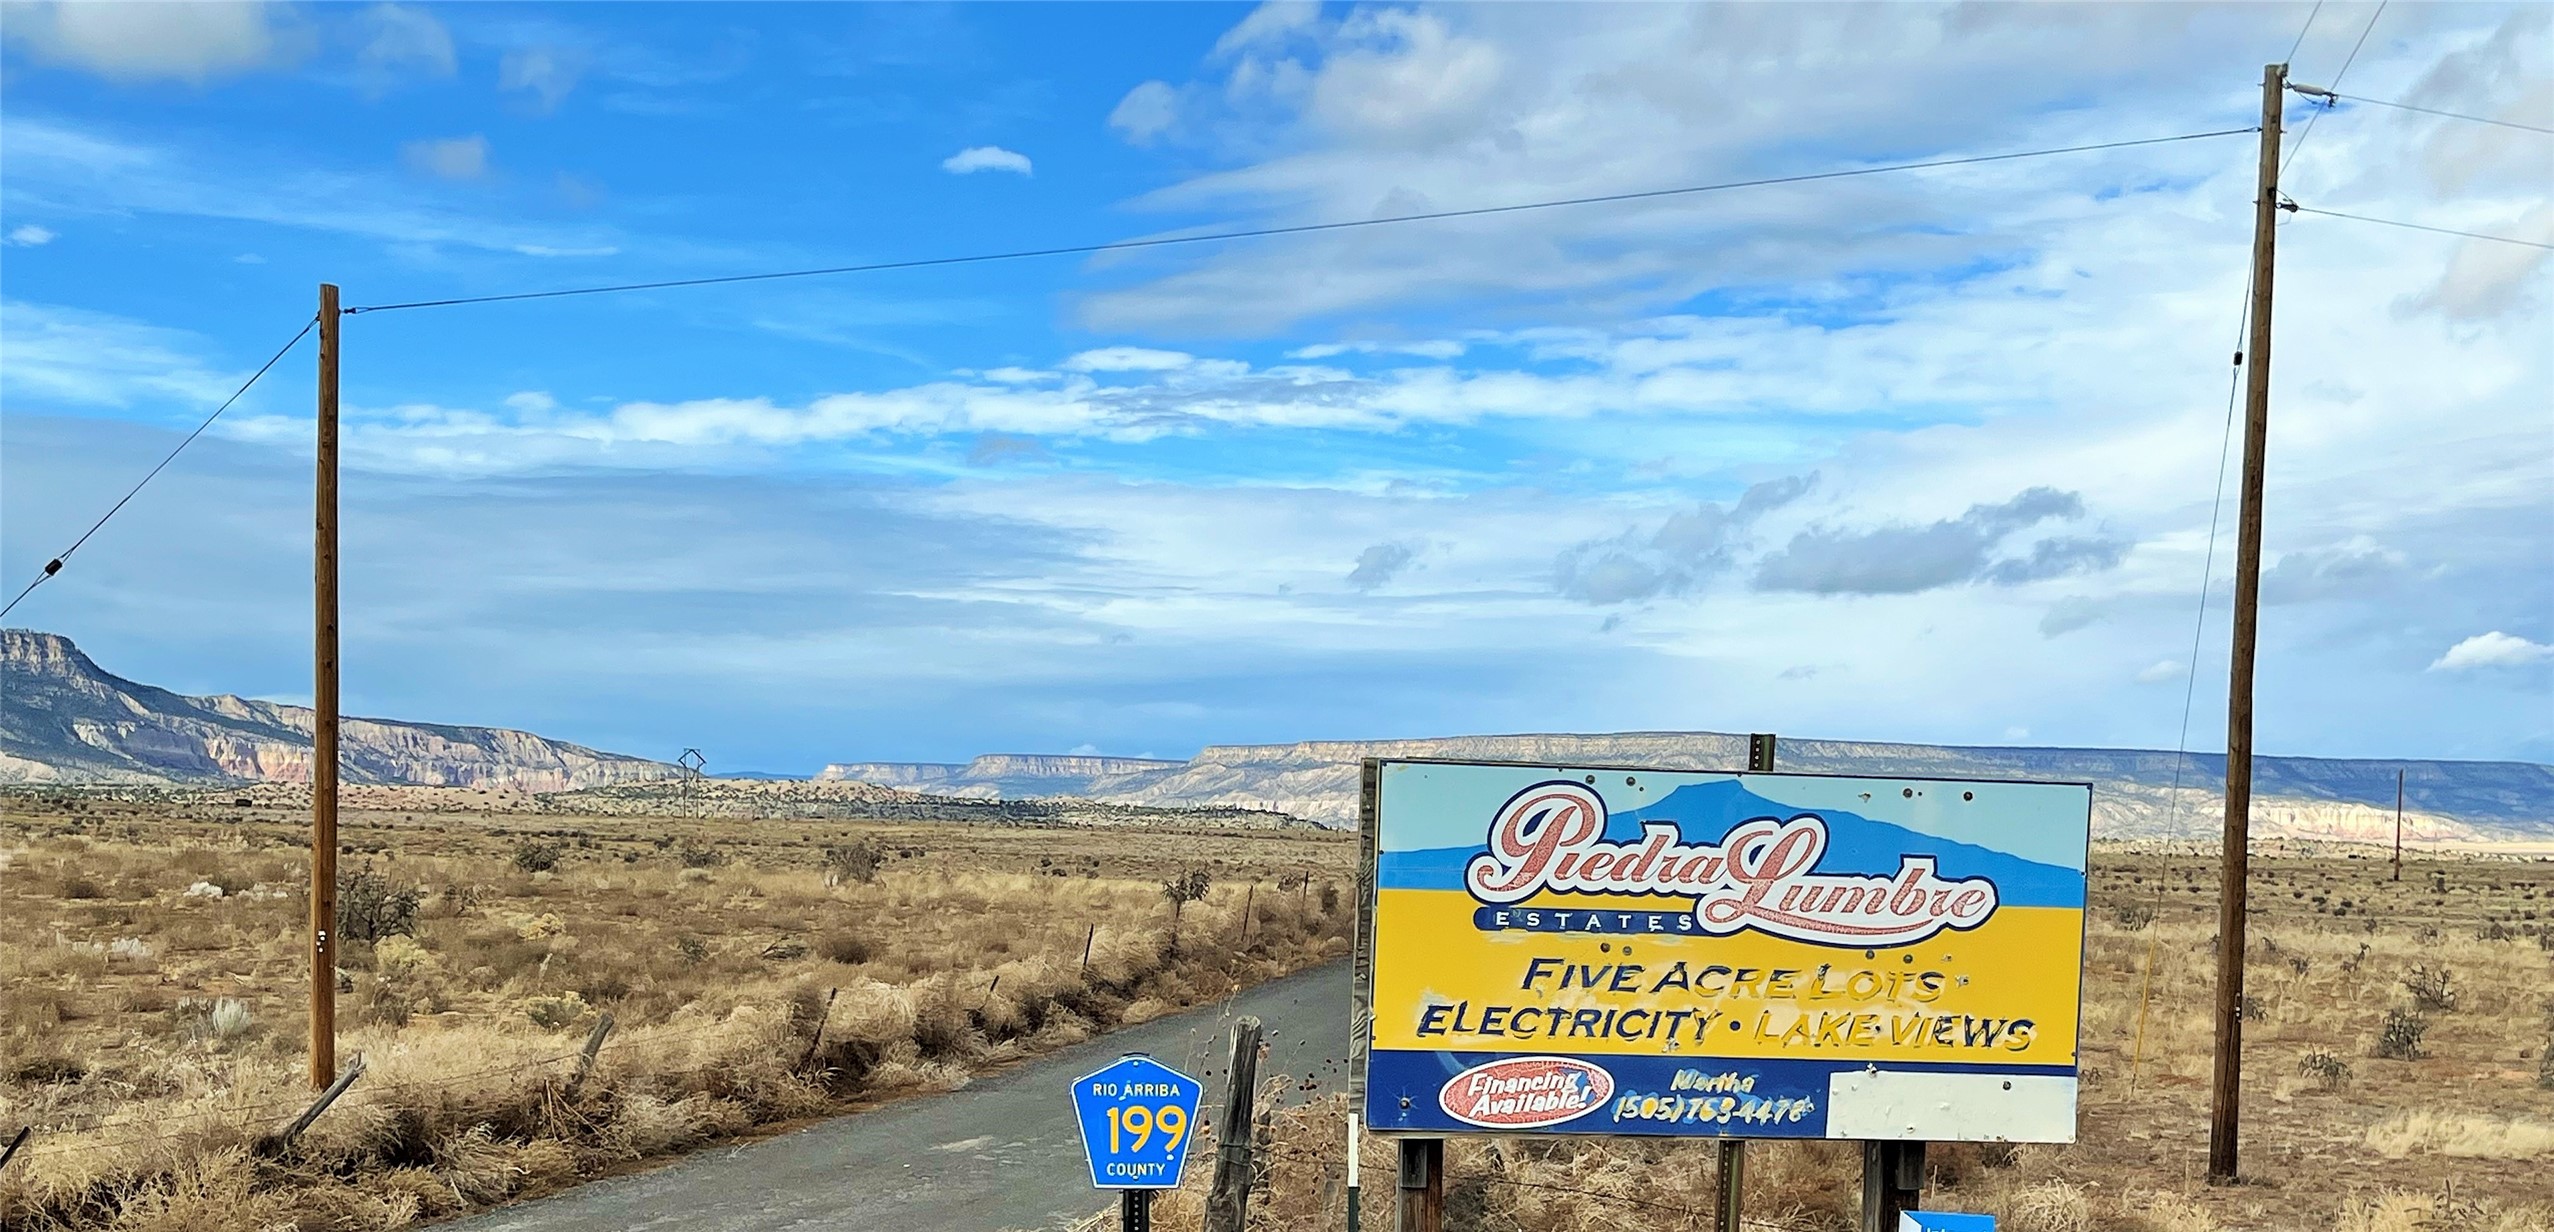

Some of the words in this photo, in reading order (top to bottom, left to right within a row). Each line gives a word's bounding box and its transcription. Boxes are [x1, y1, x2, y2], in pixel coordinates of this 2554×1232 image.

[1476, 793, 1726, 892] Piedra
[1704, 826, 1986, 936] Lumbre
[1495, 911, 1693, 933] ESTATES
[1521, 957, 1645, 992] FIVE
[1650, 961, 1801, 999] ACRE
[1808, 964, 1945, 1002] LOTS
[1417, 1001, 1722, 1046] ELECTRICITY
[1753, 1010, 1882, 1047] LAKE
[1890, 1011, 2036, 1051] VIEWS
[1093, 1084, 1118, 1097] RIO
[1124, 1084, 1181, 1097] ARRIBA
[1468, 1071, 1583, 1096] Financing
[1468, 1085, 1592, 1118] Available!
[1106, 1105, 1187, 1154] 199
[1106, 1163, 1165, 1176] COUNTY
